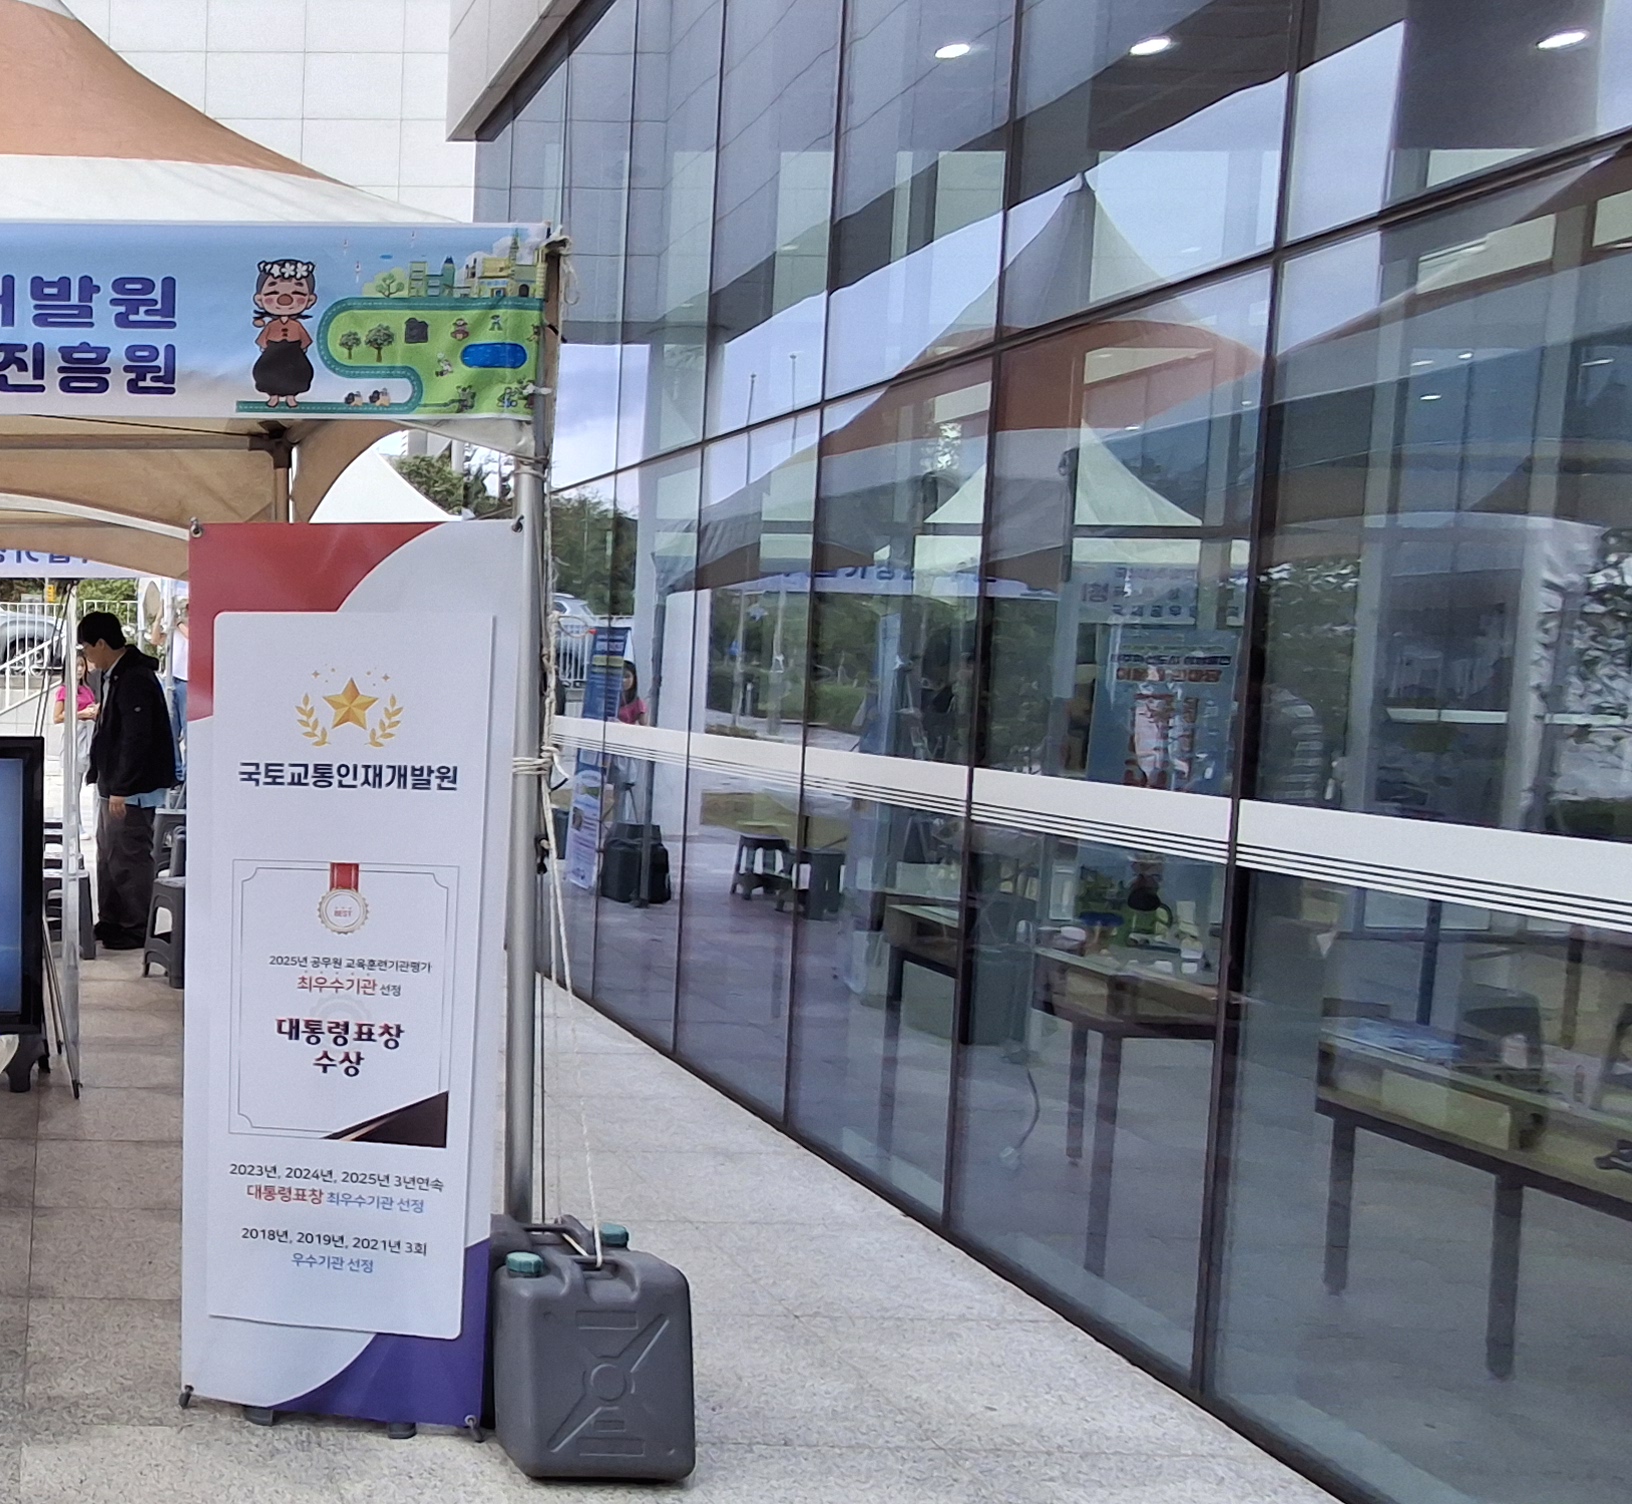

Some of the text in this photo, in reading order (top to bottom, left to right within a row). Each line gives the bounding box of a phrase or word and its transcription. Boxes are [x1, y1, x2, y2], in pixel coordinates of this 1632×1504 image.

[238, 761, 459, 791] 국토교통인재개발원
[269, 955, 308, 968] 2025년
[311, 956, 343, 969] 공무원
[297, 975, 401, 997] 최우수기관 선정
[275, 1017, 405, 1050] 대통령표창
[313, 1050, 365, 1078] 수상
[229, 1163, 282, 1180] 2023년,
[285, 1166, 338, 1184] 2024년,
[341, 1171, 390, 1187] 2025년
[246, 1183, 425, 1214] 대통령표창 최우수기관 선정
[241, 1227, 428, 1257] 2018년, 2019년, 2021년 3회
[291, 1252, 374, 1274] 우수기관 선정
